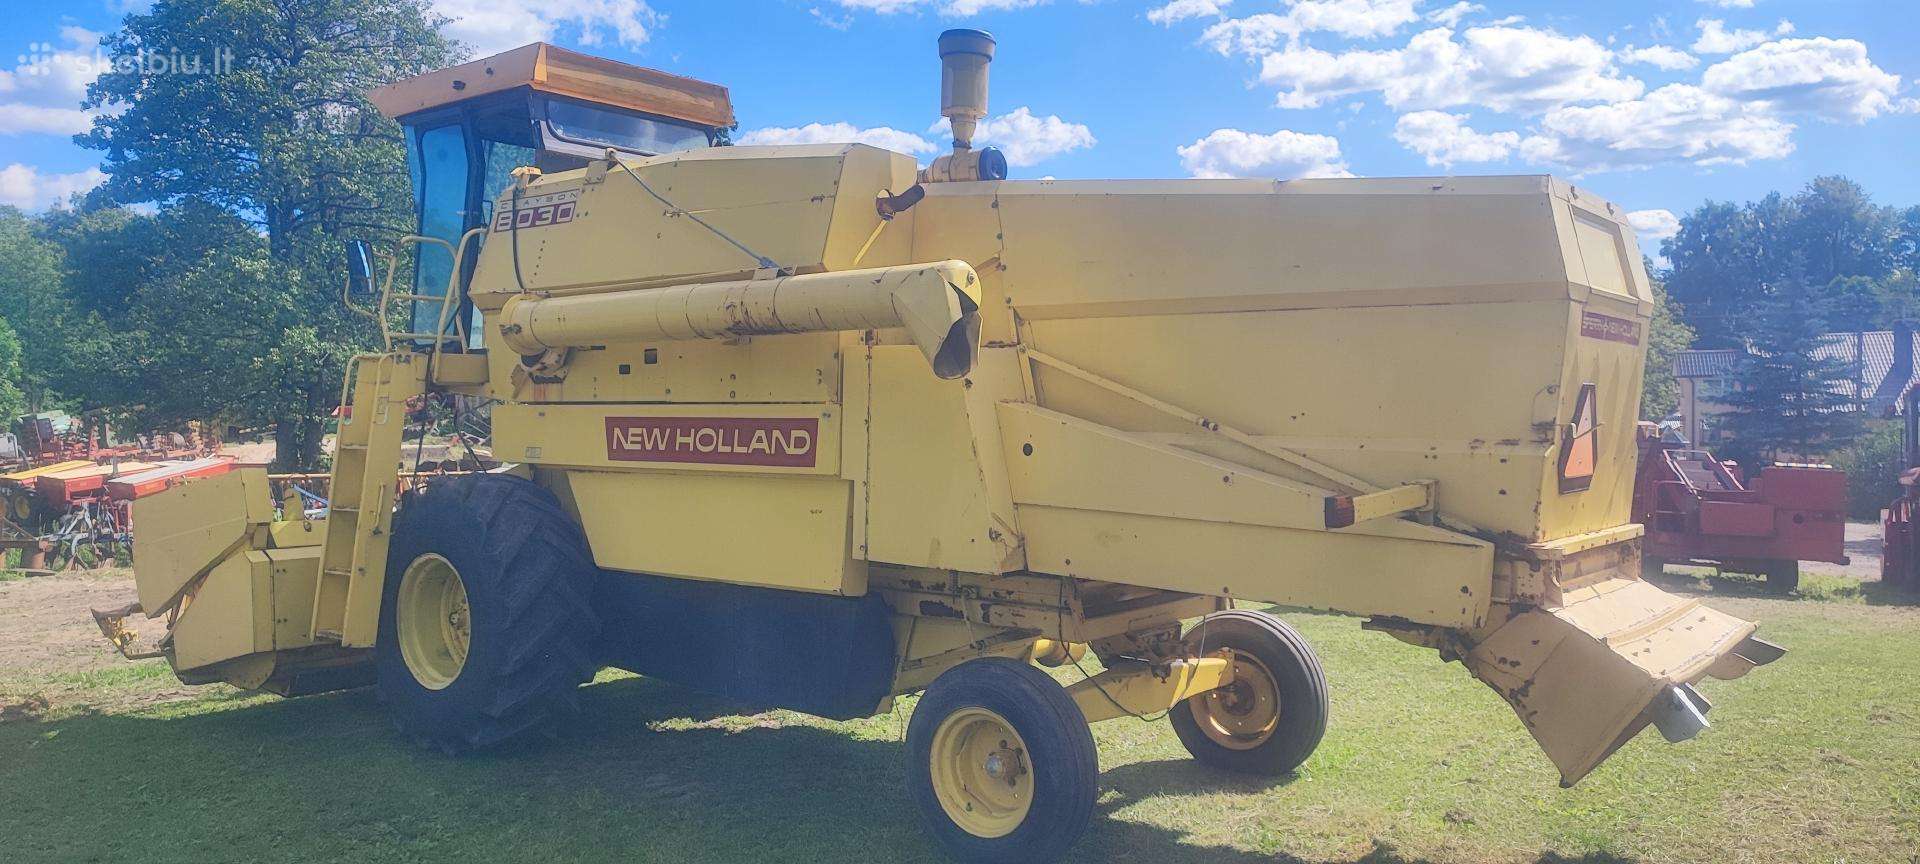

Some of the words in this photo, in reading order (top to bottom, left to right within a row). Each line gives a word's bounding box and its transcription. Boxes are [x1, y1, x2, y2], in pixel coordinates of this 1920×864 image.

[500, 193, 578, 210] CAYSON
[496, 202, 575, 230] 8030
[612, 427, 671, 450] NEW
[674, 427, 811, 454] HOLLAND
